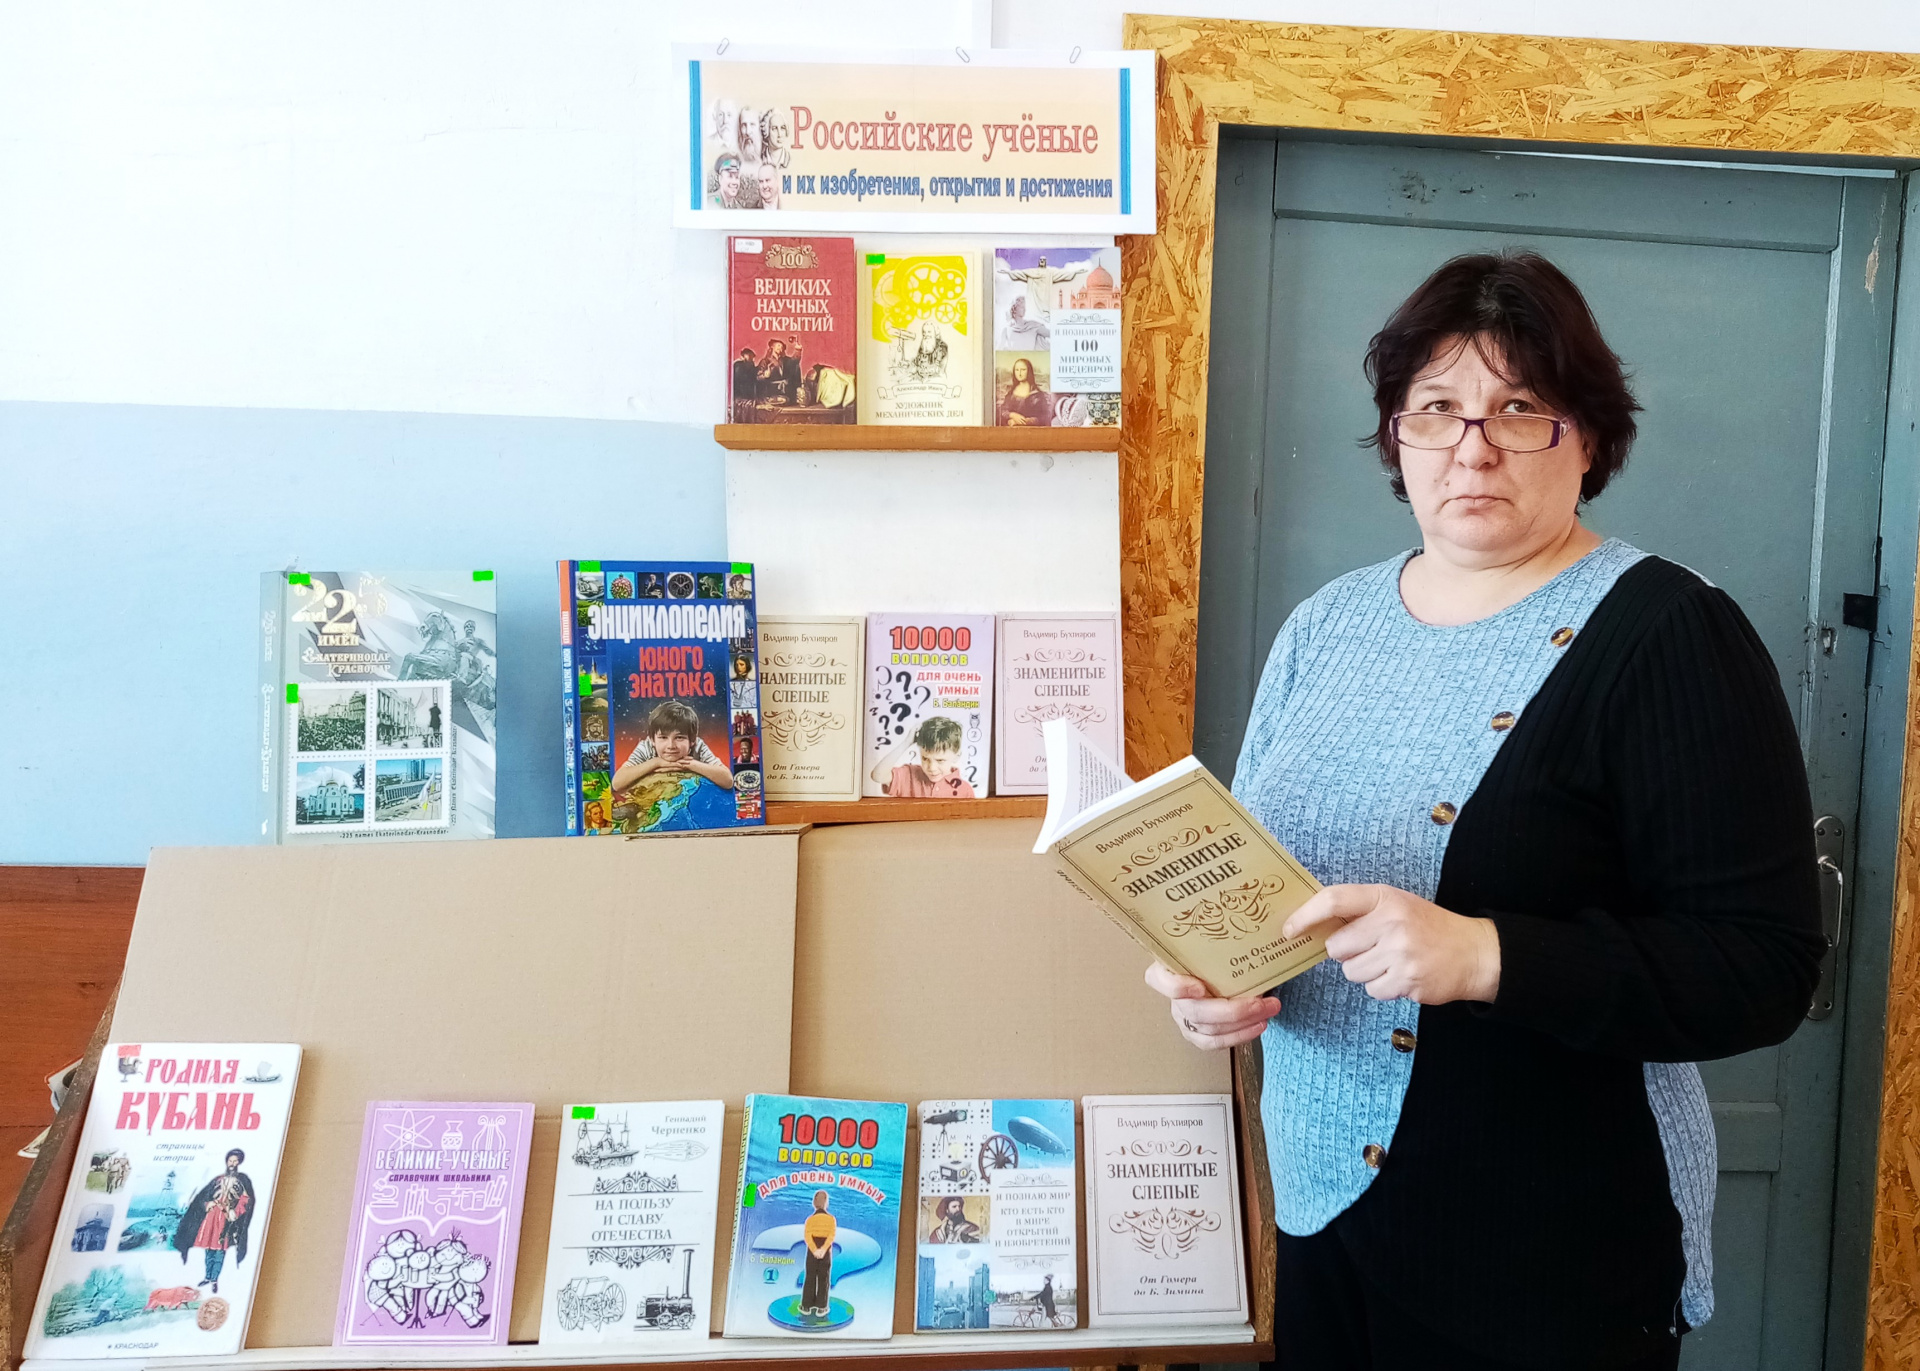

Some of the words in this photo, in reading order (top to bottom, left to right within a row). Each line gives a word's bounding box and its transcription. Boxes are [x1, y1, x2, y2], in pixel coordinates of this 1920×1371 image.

[790, 106, 972, 152] Российские
[982, 113, 1098, 162] учёные
[782, 177, 792, 194] и
[797, 176, 816, 195] их
[820, 168, 925, 202] изобретения,
[929, 177, 1001, 203] открытия
[1005, 178, 1015, 196] и
[1019, 177, 1112, 201] достижения
[781, 253, 803, 266] 100
[754, 278, 832, 296] ВЕЛИКИХ
[757, 298, 829, 314] НАУЧНЫХ
[751, 314, 834, 332] ОТКРЫТИЙ
[1073, 339, 1098, 352] 100
[1060, 355, 1111, 364] МИРОВЫХ
[1058, 365, 1114, 374] ШЕДЕВРОВ
[895, 401, 944, 410] ХУДОЖНИК
[875, 410, 944, 419] МЕХАНИЧЕСКИХ
[946, 410, 964, 418] ДЕЛ
[587, 604, 746, 643] ЭНЦИКЛОПЕДИЯ
[763, 633, 799, 644] Владимир
[801, 634, 838, 644] Бухтияров
[889, 626, 971, 651] 10000
[1023, 630, 1058, 640] Владимир
[1060, 630, 1096, 640] Бухтияров
[639, 646, 704, 671] ЮНОГО
[891, 652, 968, 667] вопросов
[759, 671, 847, 685] НАМЕНИТЫЕ
[916, 671, 941, 682] для
[944, 671, 982, 682] очень
[1014, 667, 1107, 680] ЗНАМЕНИТЫЕ
[628, 672, 716, 698] ЗНАТОКА
[937, 685, 980, 696] умных
[1034, 684, 1091, 697] СЛЕПЫЕ
[772, 689, 830, 703] СЛЕПЫЕ
[772, 763, 787, 771] От
[1095, 825, 1145, 854] Владимир
[1141, 803, 1194, 832] Бухтияров
[1159, 842, 1172, 853] 2
[1122, 832, 1247, 898] ЗНАМЕНИТЫЕ
[1165, 859, 1242, 903] СЛЕПЫЕ
[1229, 954, 1250, 967] От
[1250, 936, 1288, 957] Оссиа
[1231, 968, 1245, 979] до
[1260, 935, 1313, 966] Лапшина
[145, 1059, 240, 1085] РОДНАЯ
[115, 1092, 261, 1135] КУБАНЬ
[665, 1114, 707, 1124] Геннадий
[1117, 1117, 1158, 1129] Владимир
[1161, 1117, 1204, 1129] Бухтияров
[651, 1124, 706, 1136] Черненко
[779, 1113, 880, 1150] 10000
[156, 1142, 206, 1153] страницы
[153, 1153, 196, 1163] истории
[374, 1149, 444, 1171] ВЕЛИКИЕ
[450, 1149, 510, 1171] УЧЕНЫЕ
[778, 1147, 874, 1168] вопросов
[1107, 1162, 1218, 1179] ЗНАМЕНИТЫЕ
[389, 1173, 440, 1183] СПРАВОЧНИК
[443, 1173, 492, 1183] ШКОЛЬНИКА
[758, 1176, 787, 1199] для
[791, 1170, 835, 1186] очень
[839, 1175, 886, 1206] умных
[1132, 1184, 1200, 1200] СЛЕПЫЕ
[1005, 1192, 1047, 1200] ПОЗНАЮ
[1049, 1192, 1071, 1200] МИР
[595, 1199, 614, 1211] НА
[619, 1197, 675, 1210] ПОЛЬЗУ
[1000, 1207, 1019, 1215] КТО
[1021, 1207, 1044, 1215] ЕСТЬ
[1047, 1207, 1065, 1215] КТО
[603, 1214, 614, 1226] И
[618, 1213, 664, 1226] СЛАВУ
[1024, 1217, 1050, 1225] МИРЕ
[591, 1229, 673, 1242] ОТЕЧЕСТВА
[1006, 1226, 1059, 1236] ОТКРЫТИЙ
[1004, 1237, 1071, 1247] ИЗОБРЕТЕНИЙ
[767, 1270, 775, 1281] 1
[1139, 1274, 1157, 1285] От
[1161, 1275, 1197, 1286] Гомера
[1133, 1287, 1147, 1296] до
[1163, 1287, 1204, 1296] Зимина
[113, 1341, 160, 1350] КРАСНОДАР
